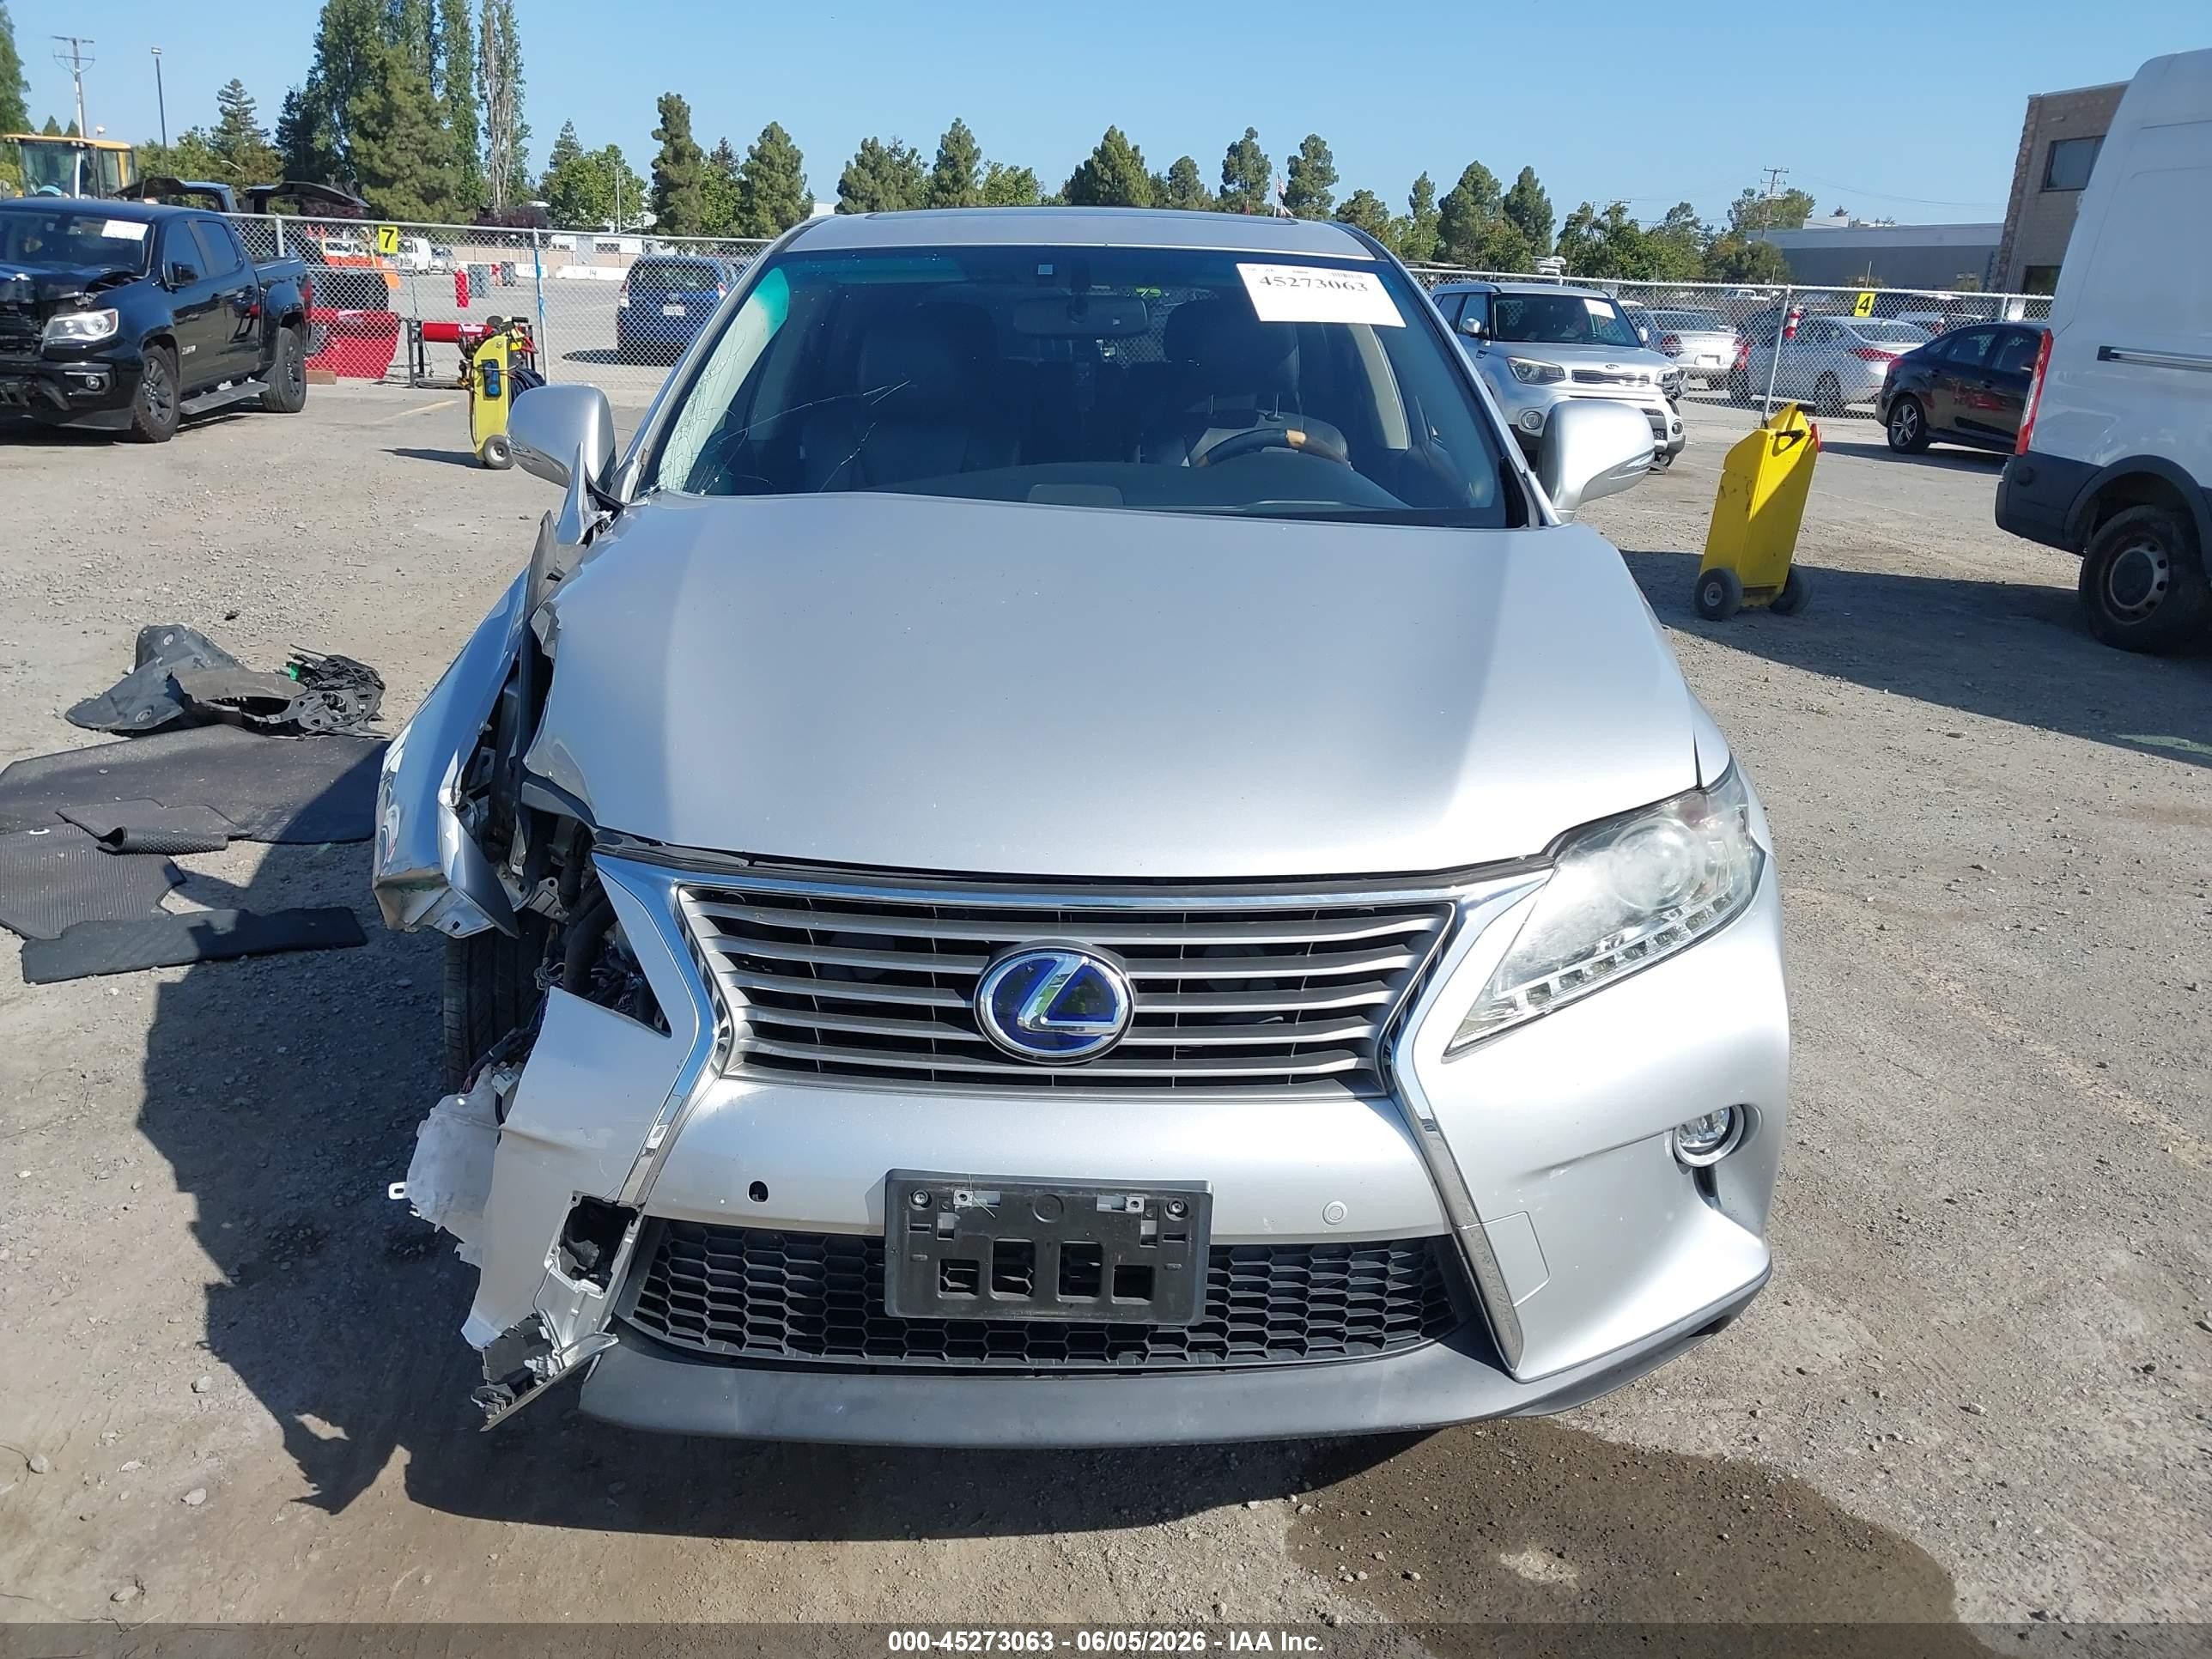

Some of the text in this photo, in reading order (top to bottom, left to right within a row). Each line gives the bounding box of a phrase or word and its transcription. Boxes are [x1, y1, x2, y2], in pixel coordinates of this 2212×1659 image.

[381, 228, 394, 249] 7
[1259, 276, 1368, 292] 45273063
[1858, 295, 1871, 313] 4
